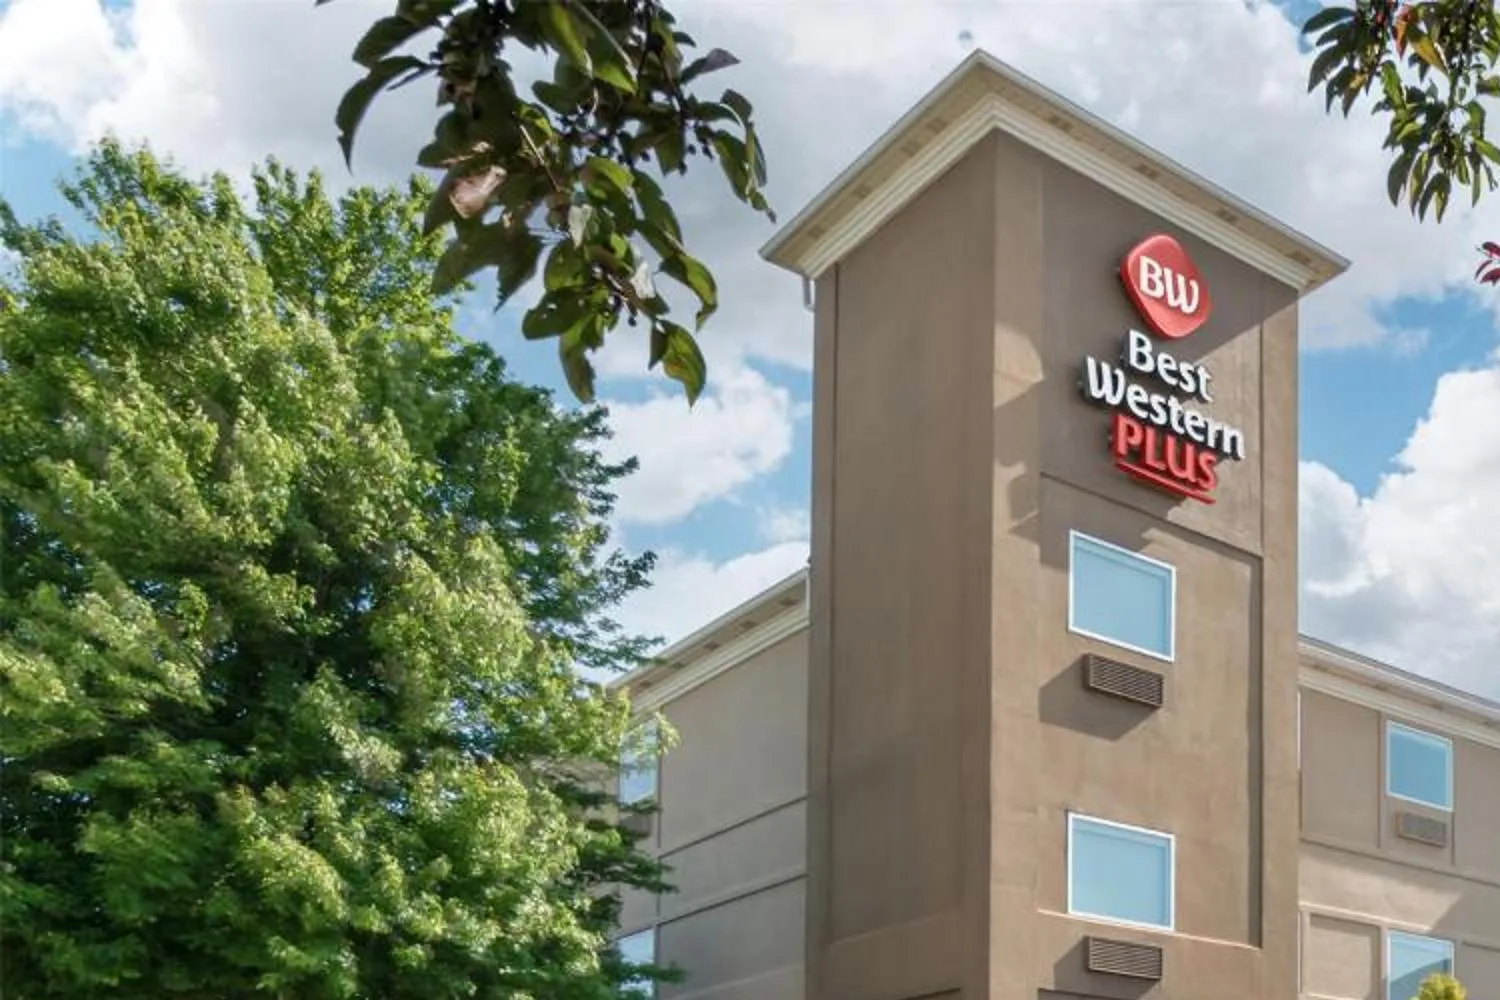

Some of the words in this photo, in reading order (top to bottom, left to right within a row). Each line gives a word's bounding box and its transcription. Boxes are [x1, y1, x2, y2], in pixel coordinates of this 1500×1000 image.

[1140, 255, 1199, 314] BW
[1129, 329, 1213, 402] Best
[1086, 356, 1246, 459] Western
[1115, 414, 1217, 490] PLUS
